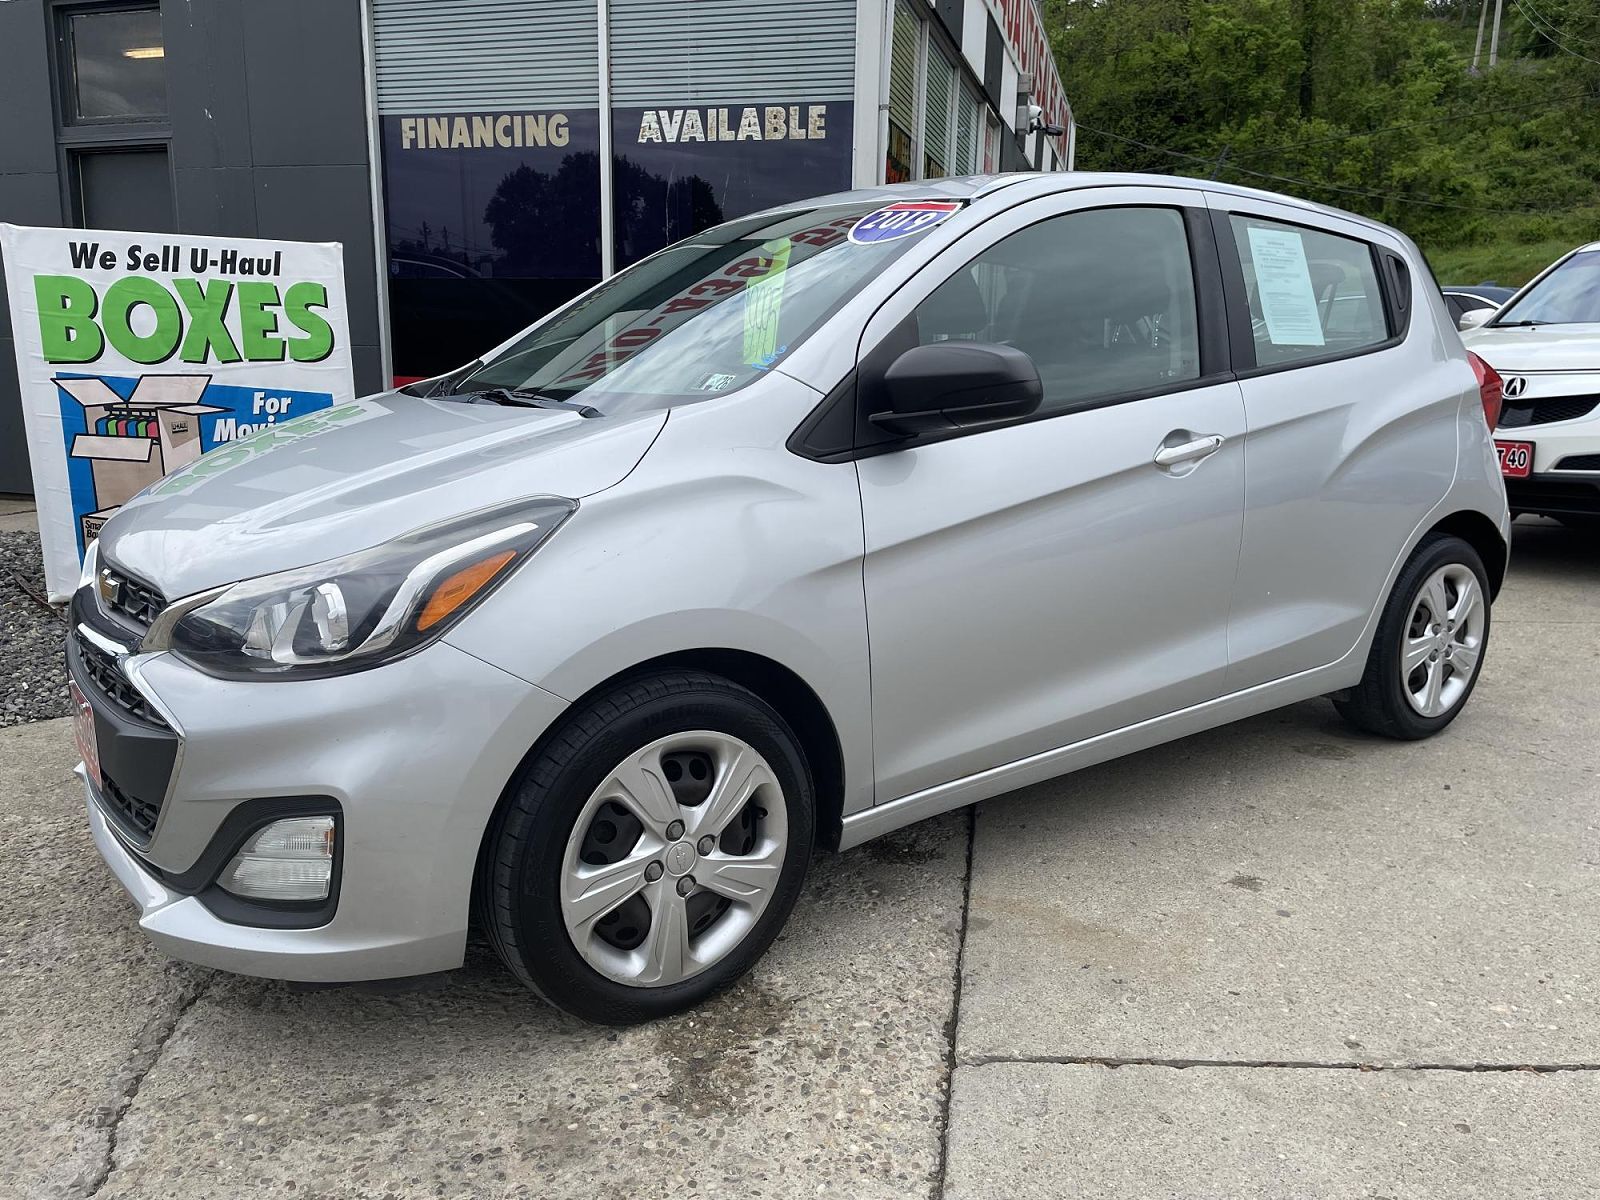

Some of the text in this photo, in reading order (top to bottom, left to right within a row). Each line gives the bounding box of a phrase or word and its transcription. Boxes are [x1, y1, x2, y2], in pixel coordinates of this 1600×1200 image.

[401, 105, 827, 149] FINANCING AVAILABLE
[859, 211, 937, 231] 2019
[69, 242, 282, 276] We Sell U-Haul
[34, 275, 335, 364] BOXES
[253, 391, 292, 415] For
[1507, 448, 1527, 468] 40
[87, 530, 99, 539] Bo
